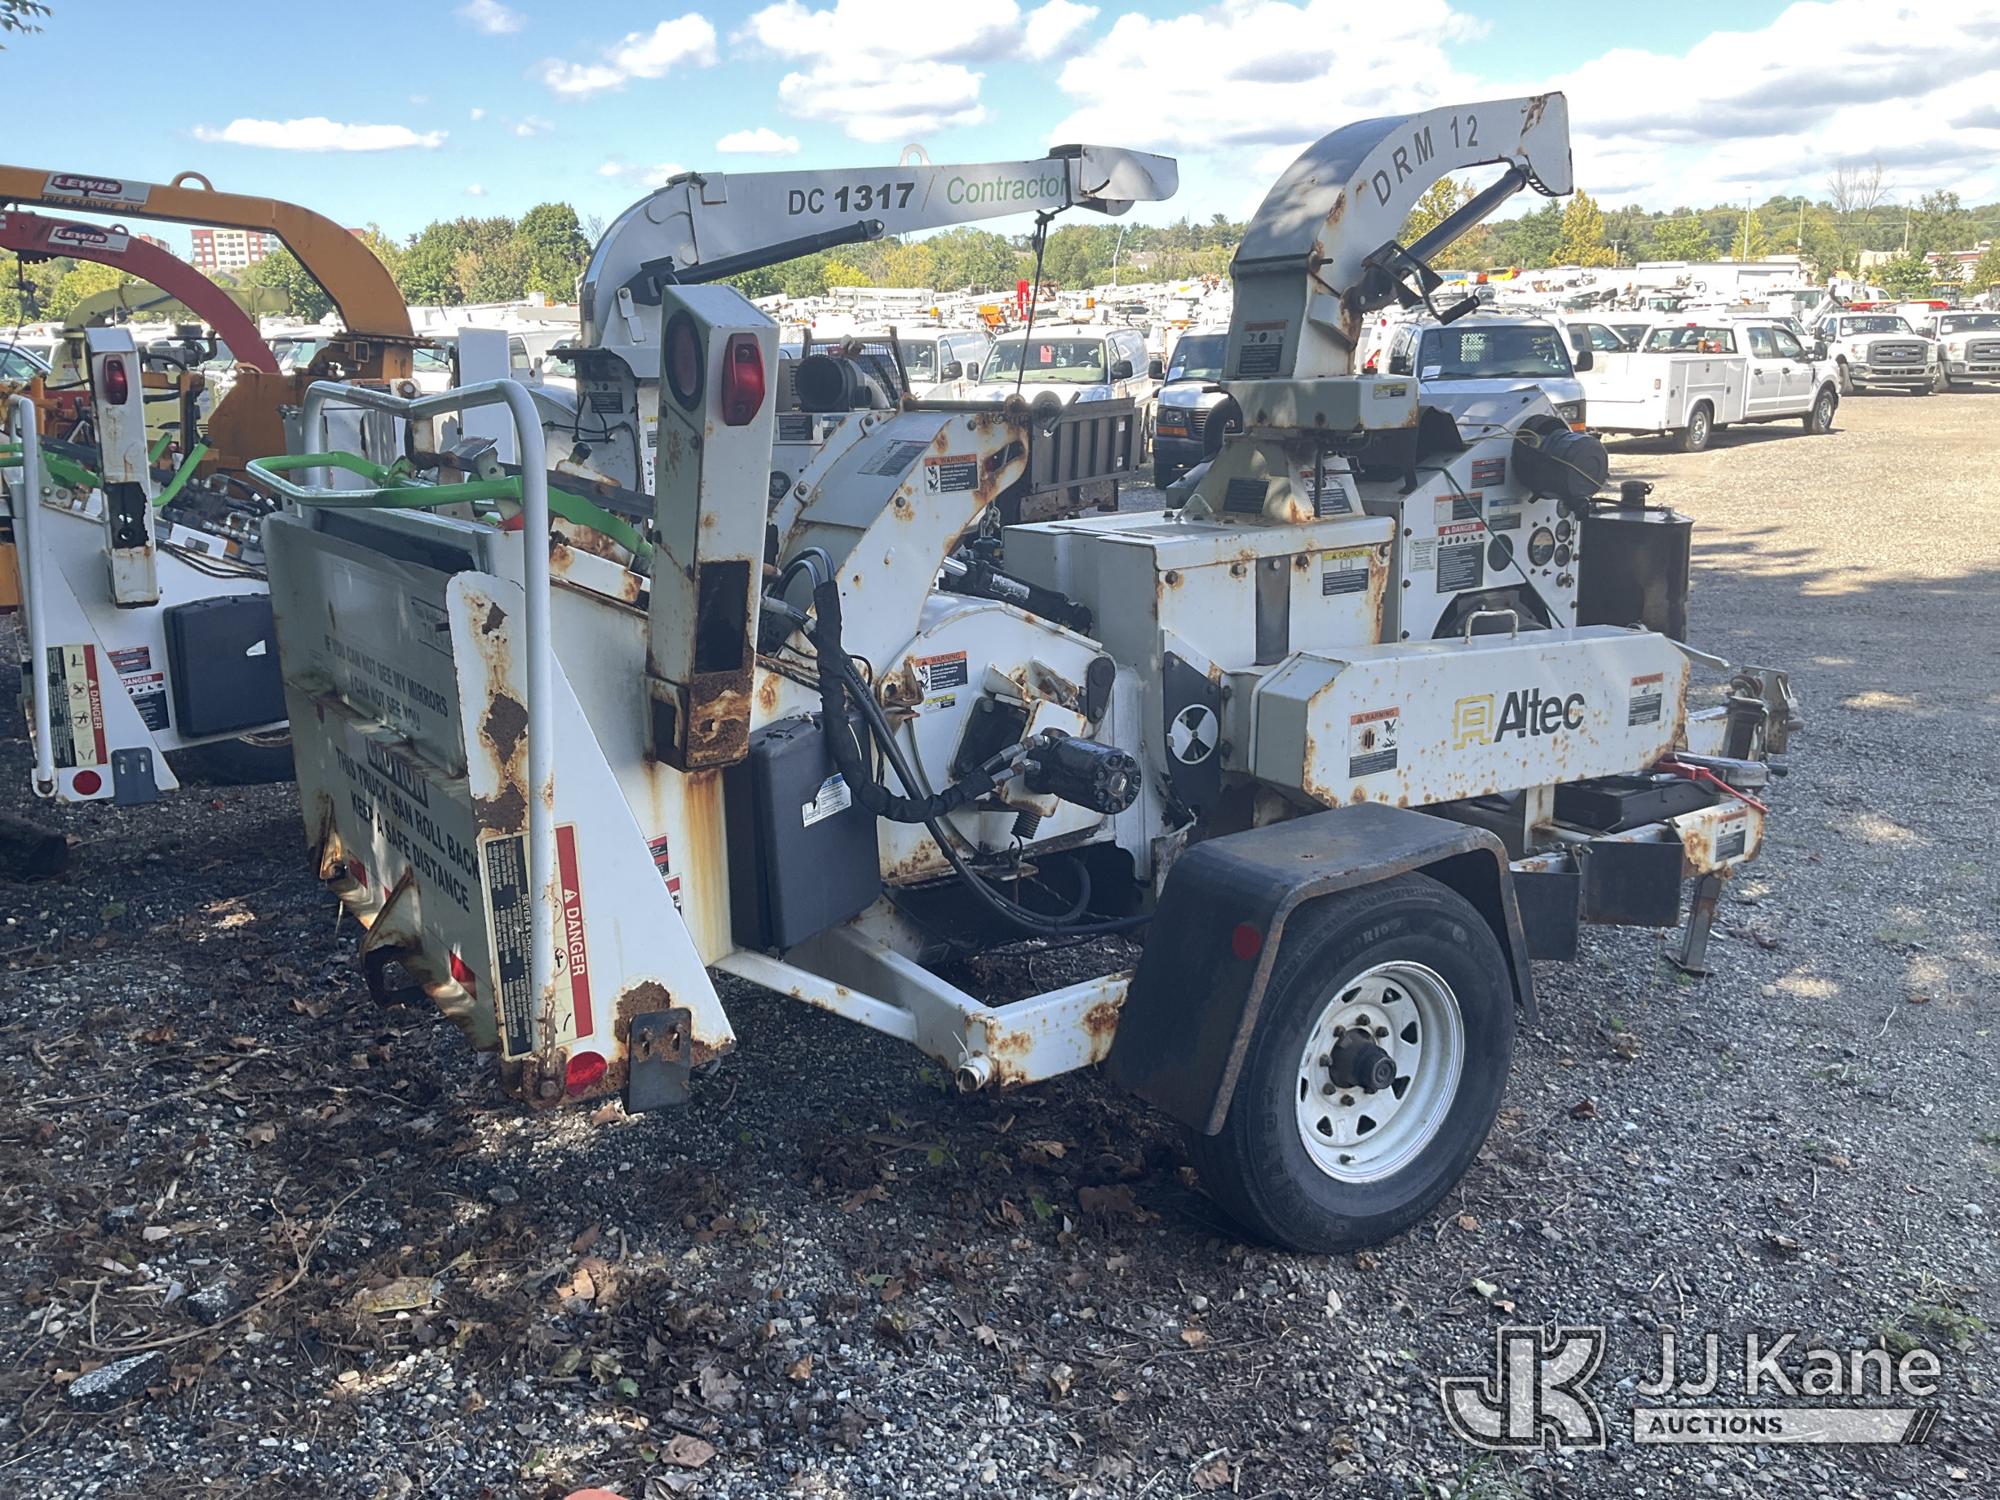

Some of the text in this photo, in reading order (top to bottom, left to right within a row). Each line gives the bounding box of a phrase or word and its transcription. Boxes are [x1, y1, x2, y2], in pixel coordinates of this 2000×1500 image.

[1372, 114, 1478, 207] DRM 12
[53, 178, 118, 192] LEWIS
[788, 174, 1067, 215] DC 1317 Contractor
[57, 230, 105, 242] LEWIS
[1451, 524, 1477, 533] DANGER
[930, 652, 960, 663] WARNING
[89, 690, 103, 730] DANGER
[393, 670, 406, 694] MY
[407, 677, 448, 718] MIRRORS
[1494, 688, 1585, 743] Altec
[336, 746, 481, 884] THIS TRUCK CAN ROLL BACK
[376, 812, 384, 837] A
[385, 818, 411, 860] SAFE
[412, 842, 470, 913] DISTANCE
[521, 893, 531, 922] SEVER
[566, 907, 585, 976] DANGER
